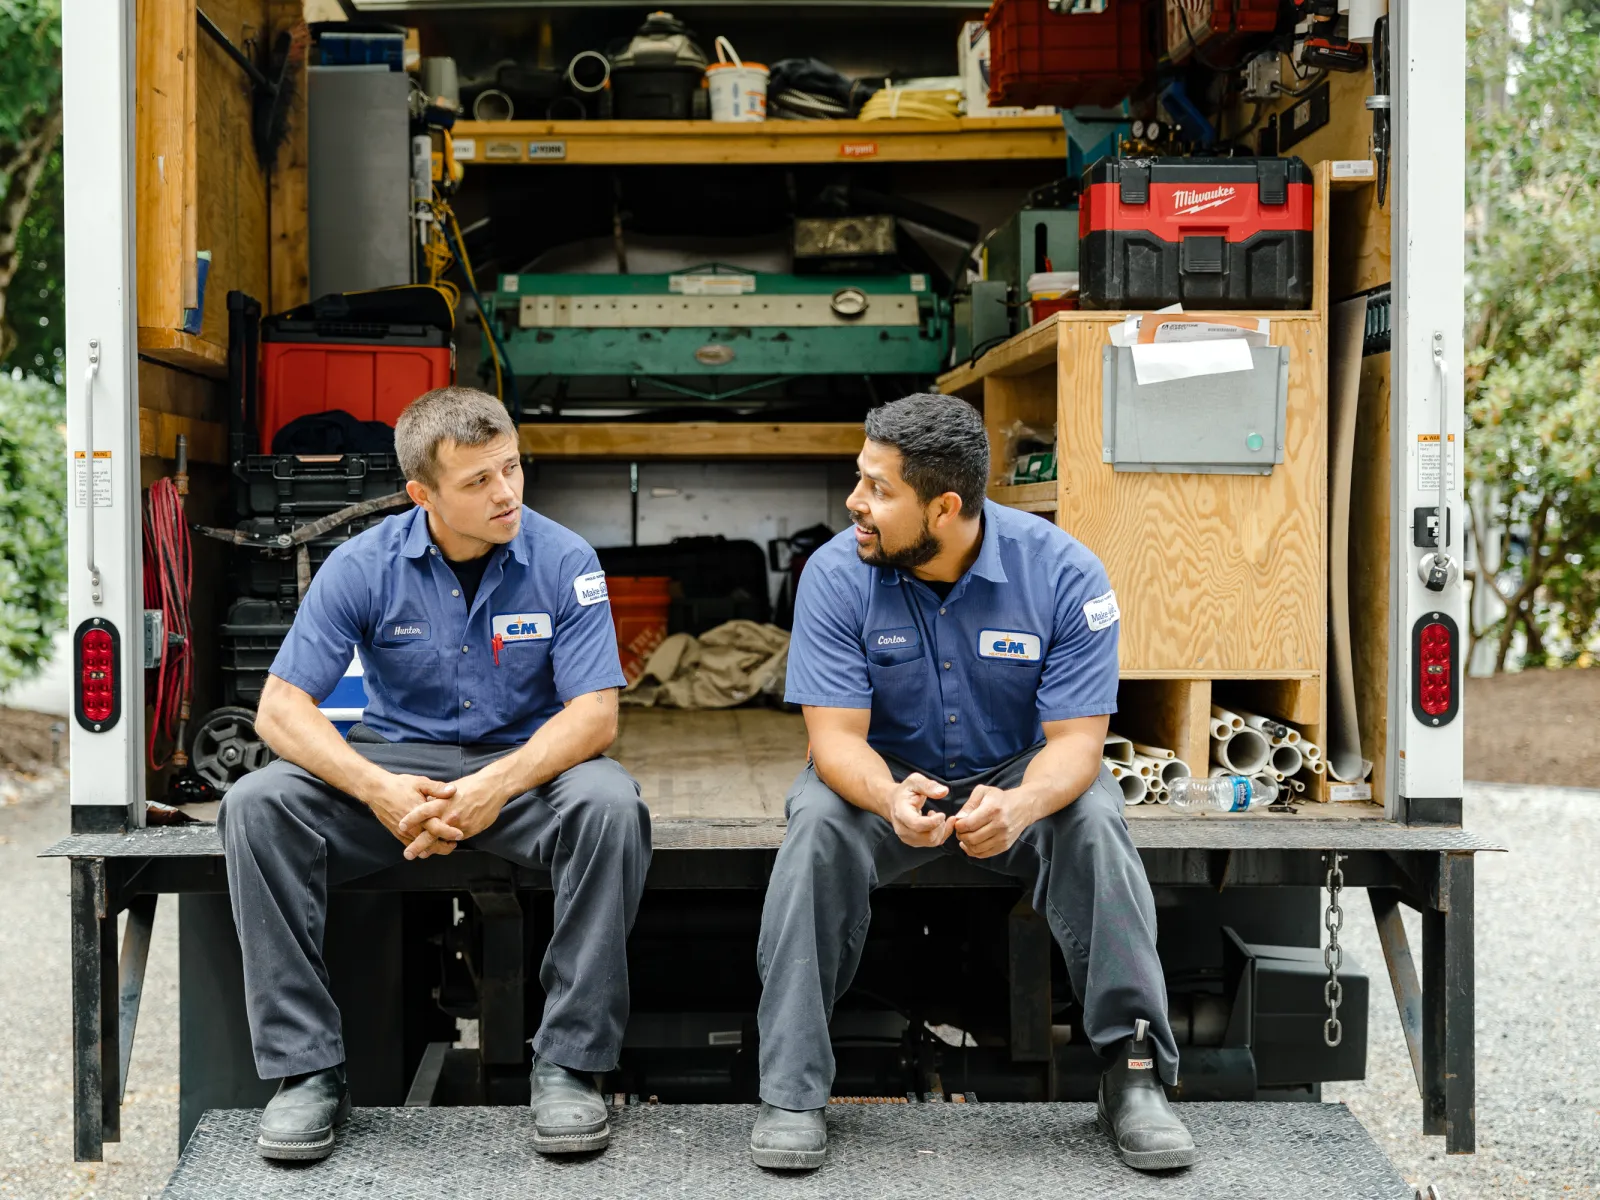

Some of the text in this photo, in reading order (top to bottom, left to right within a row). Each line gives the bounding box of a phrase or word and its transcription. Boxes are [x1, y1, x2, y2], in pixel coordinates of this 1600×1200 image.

[1172, 185, 1236, 209] Milwaukee
[394, 626, 422, 636] Hunter
[878, 635, 907, 645] Carlos
